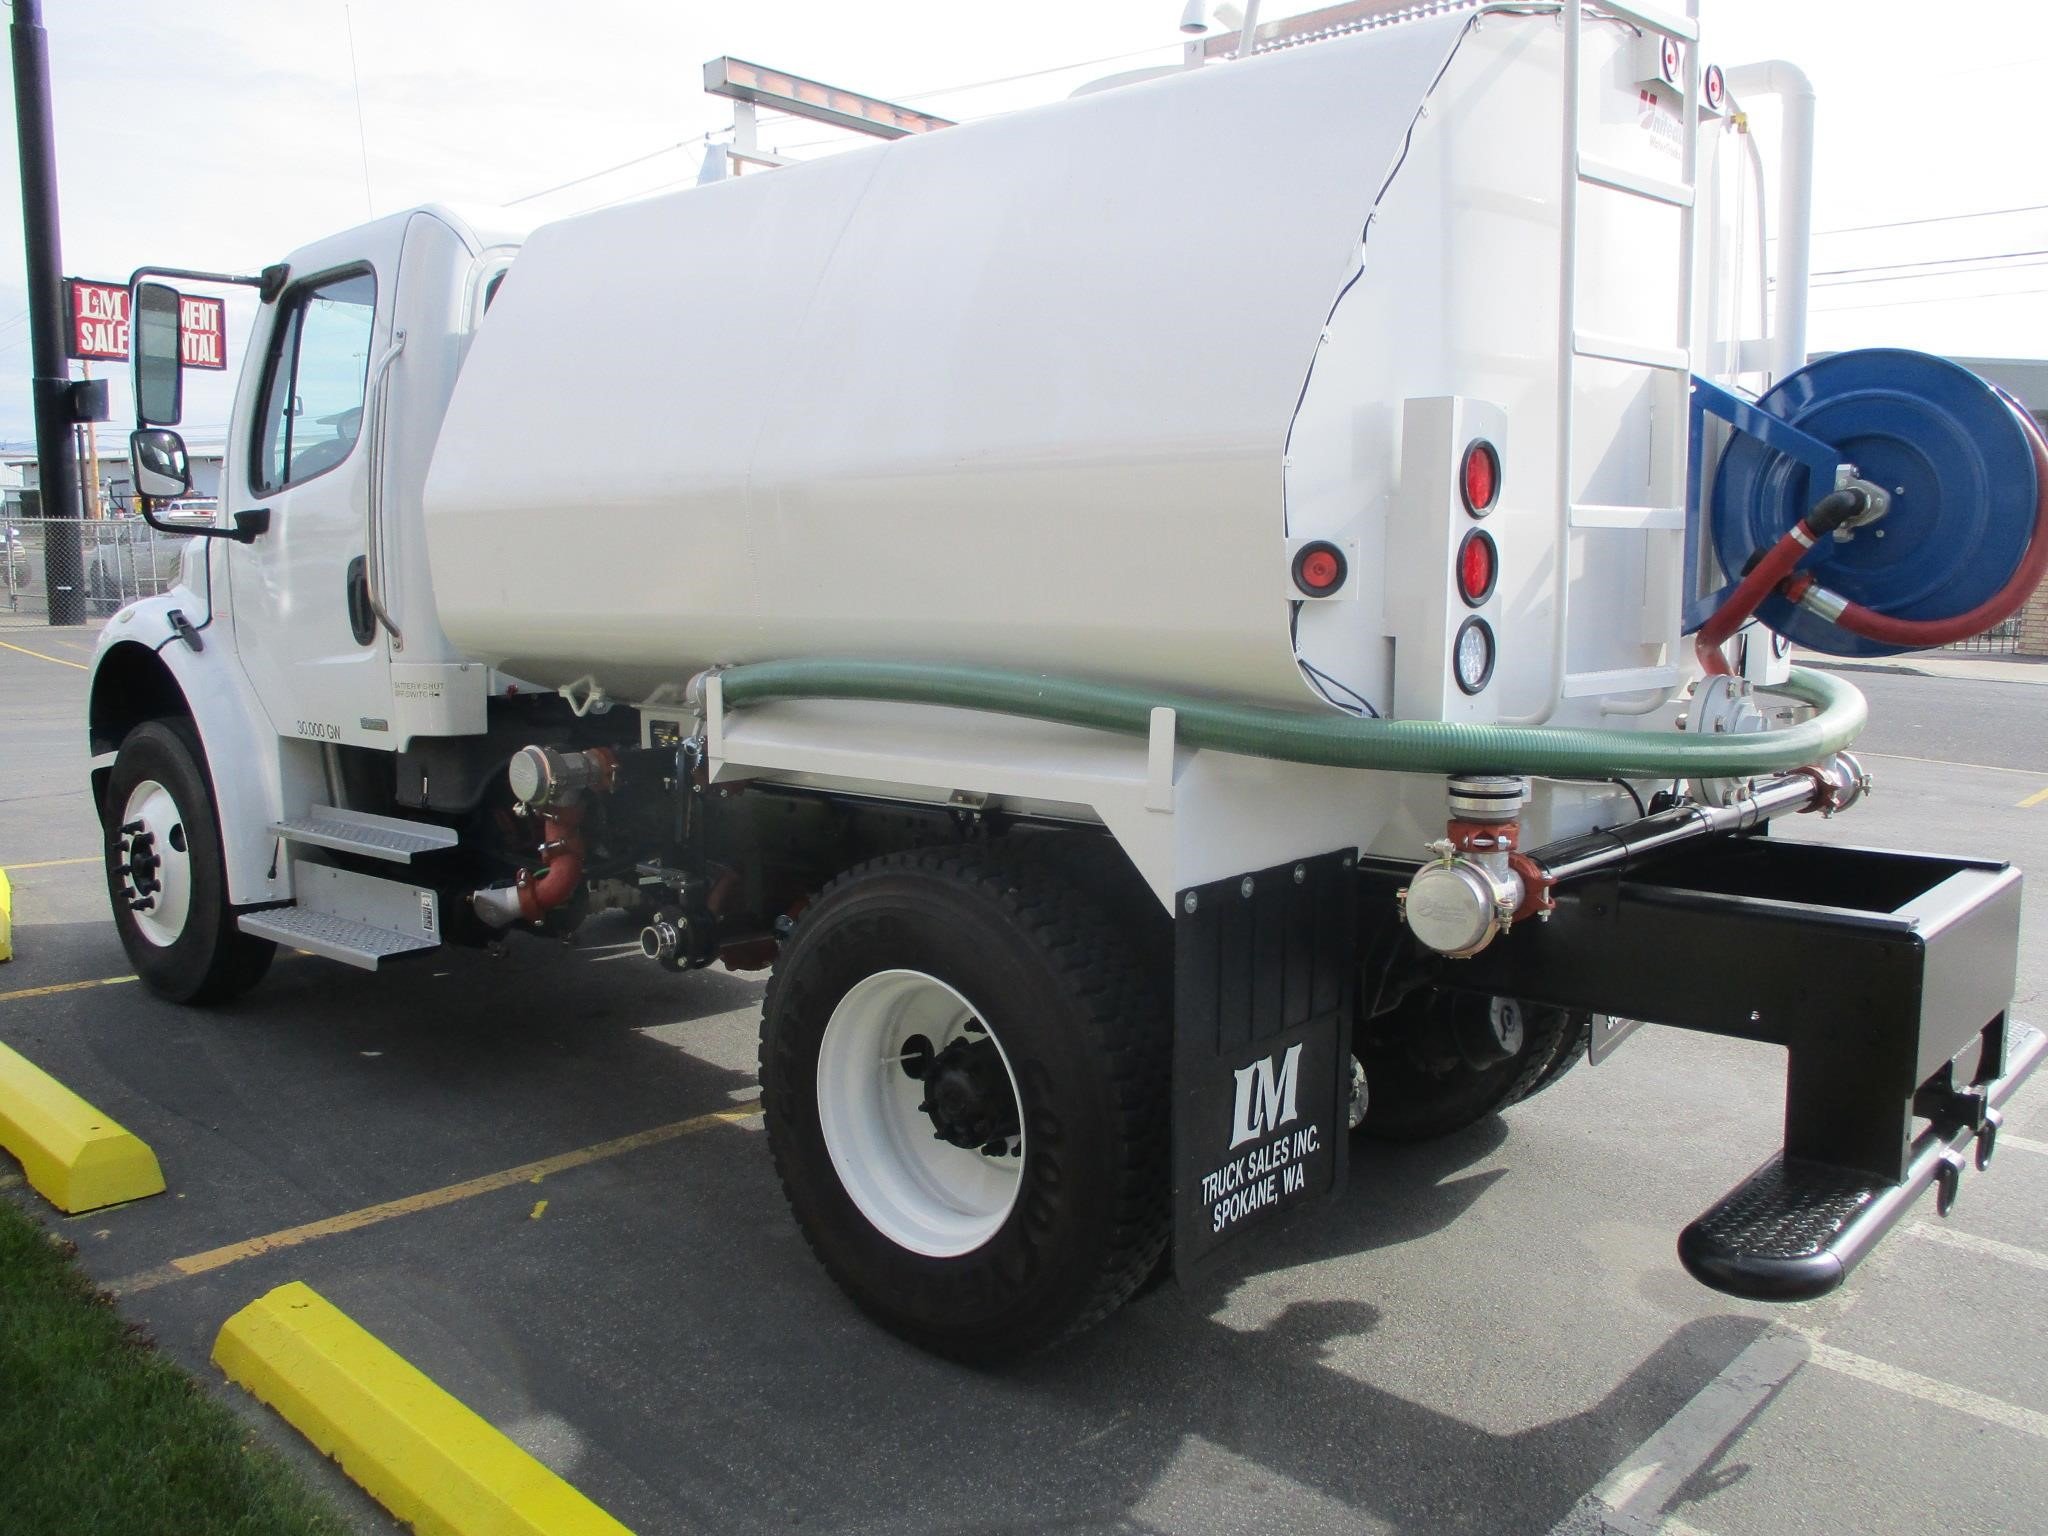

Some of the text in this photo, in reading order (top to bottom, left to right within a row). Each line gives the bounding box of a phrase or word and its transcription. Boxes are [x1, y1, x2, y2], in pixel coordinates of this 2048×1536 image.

[80, 287, 123, 321] L&M
[1202, 1124, 1320, 1205] TRUCK SALES INC.
[1213, 1162, 1304, 1233] SPOKANE, WA
